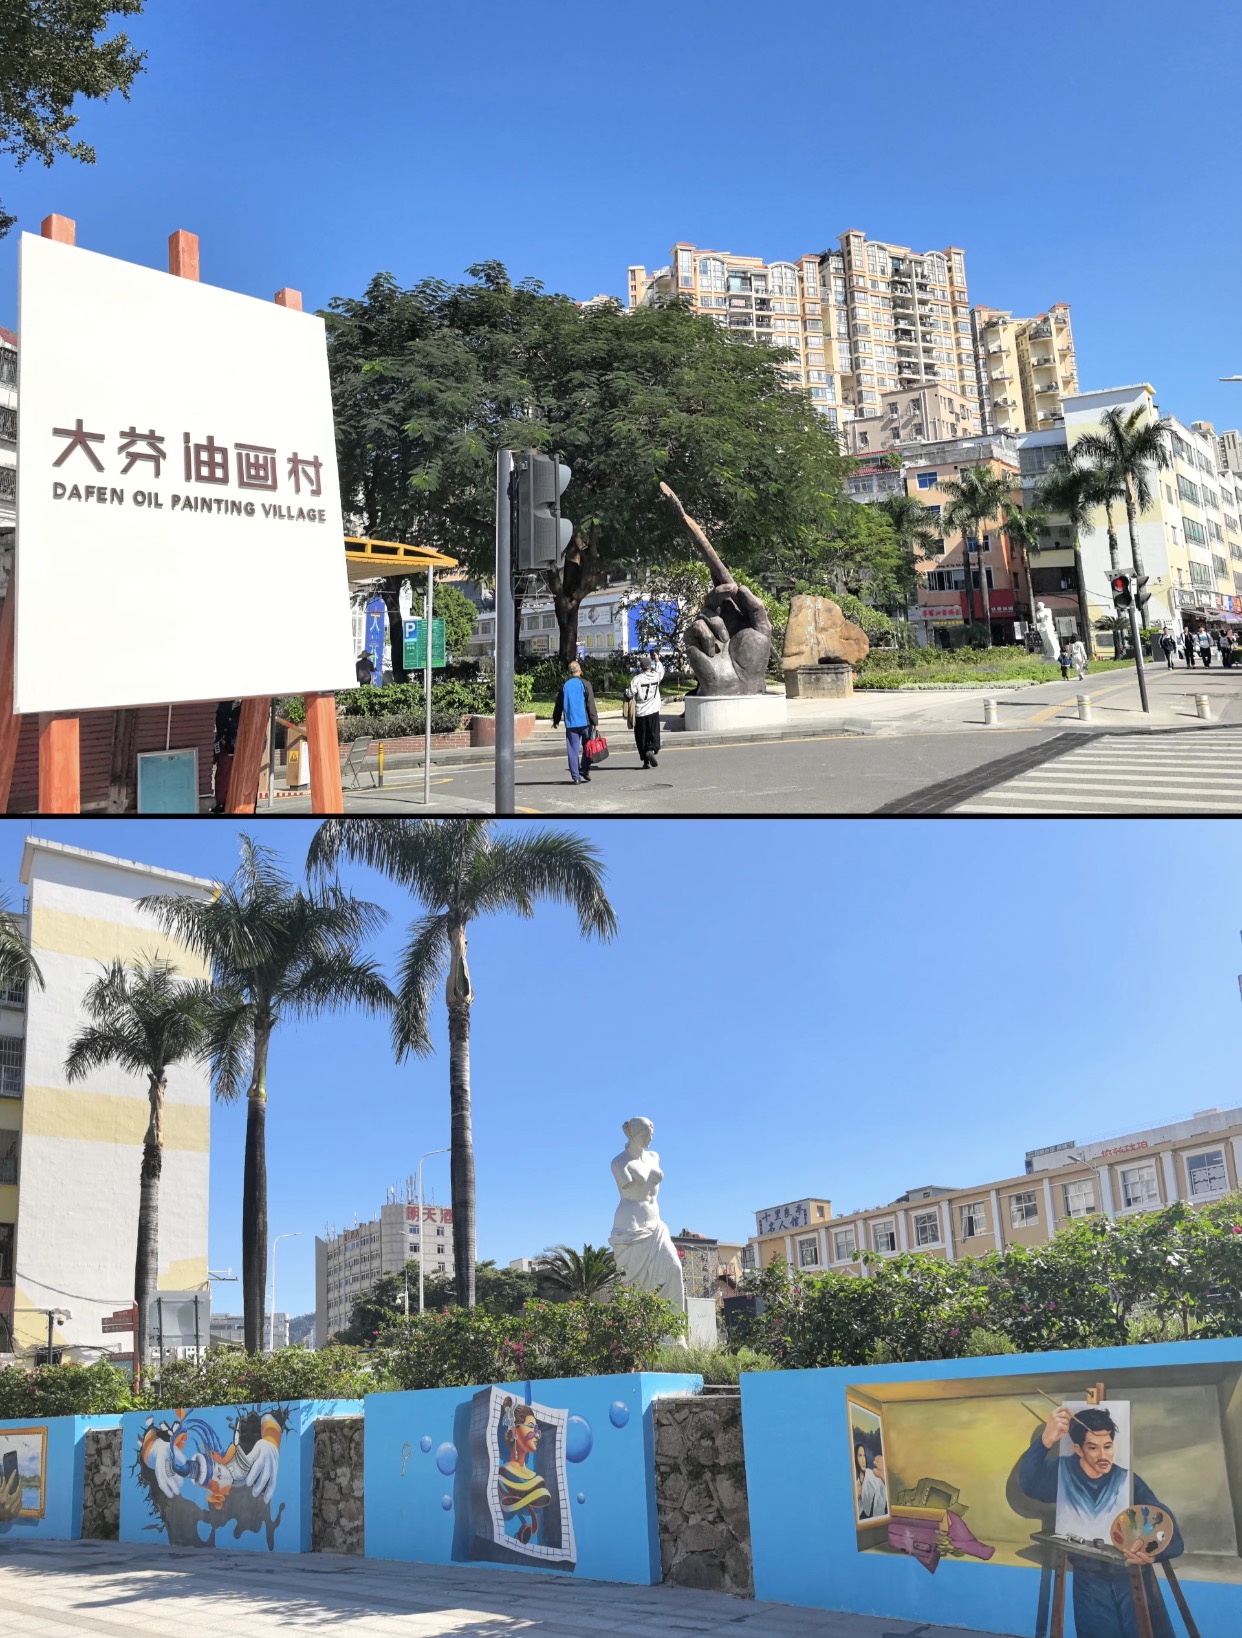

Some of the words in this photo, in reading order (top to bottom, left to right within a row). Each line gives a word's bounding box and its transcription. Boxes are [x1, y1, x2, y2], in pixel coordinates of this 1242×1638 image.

[52, 418, 323, 497] 大芬油画村
[53, 482, 124, 505] DAFEN
[132, 490, 163, 508] OIL
[171, 494, 256, 518] PAINTING
[261, 502, 327, 524] VILLAGE
[406, 622, 416, 638] P
[640, 681, 660, 701] 77
